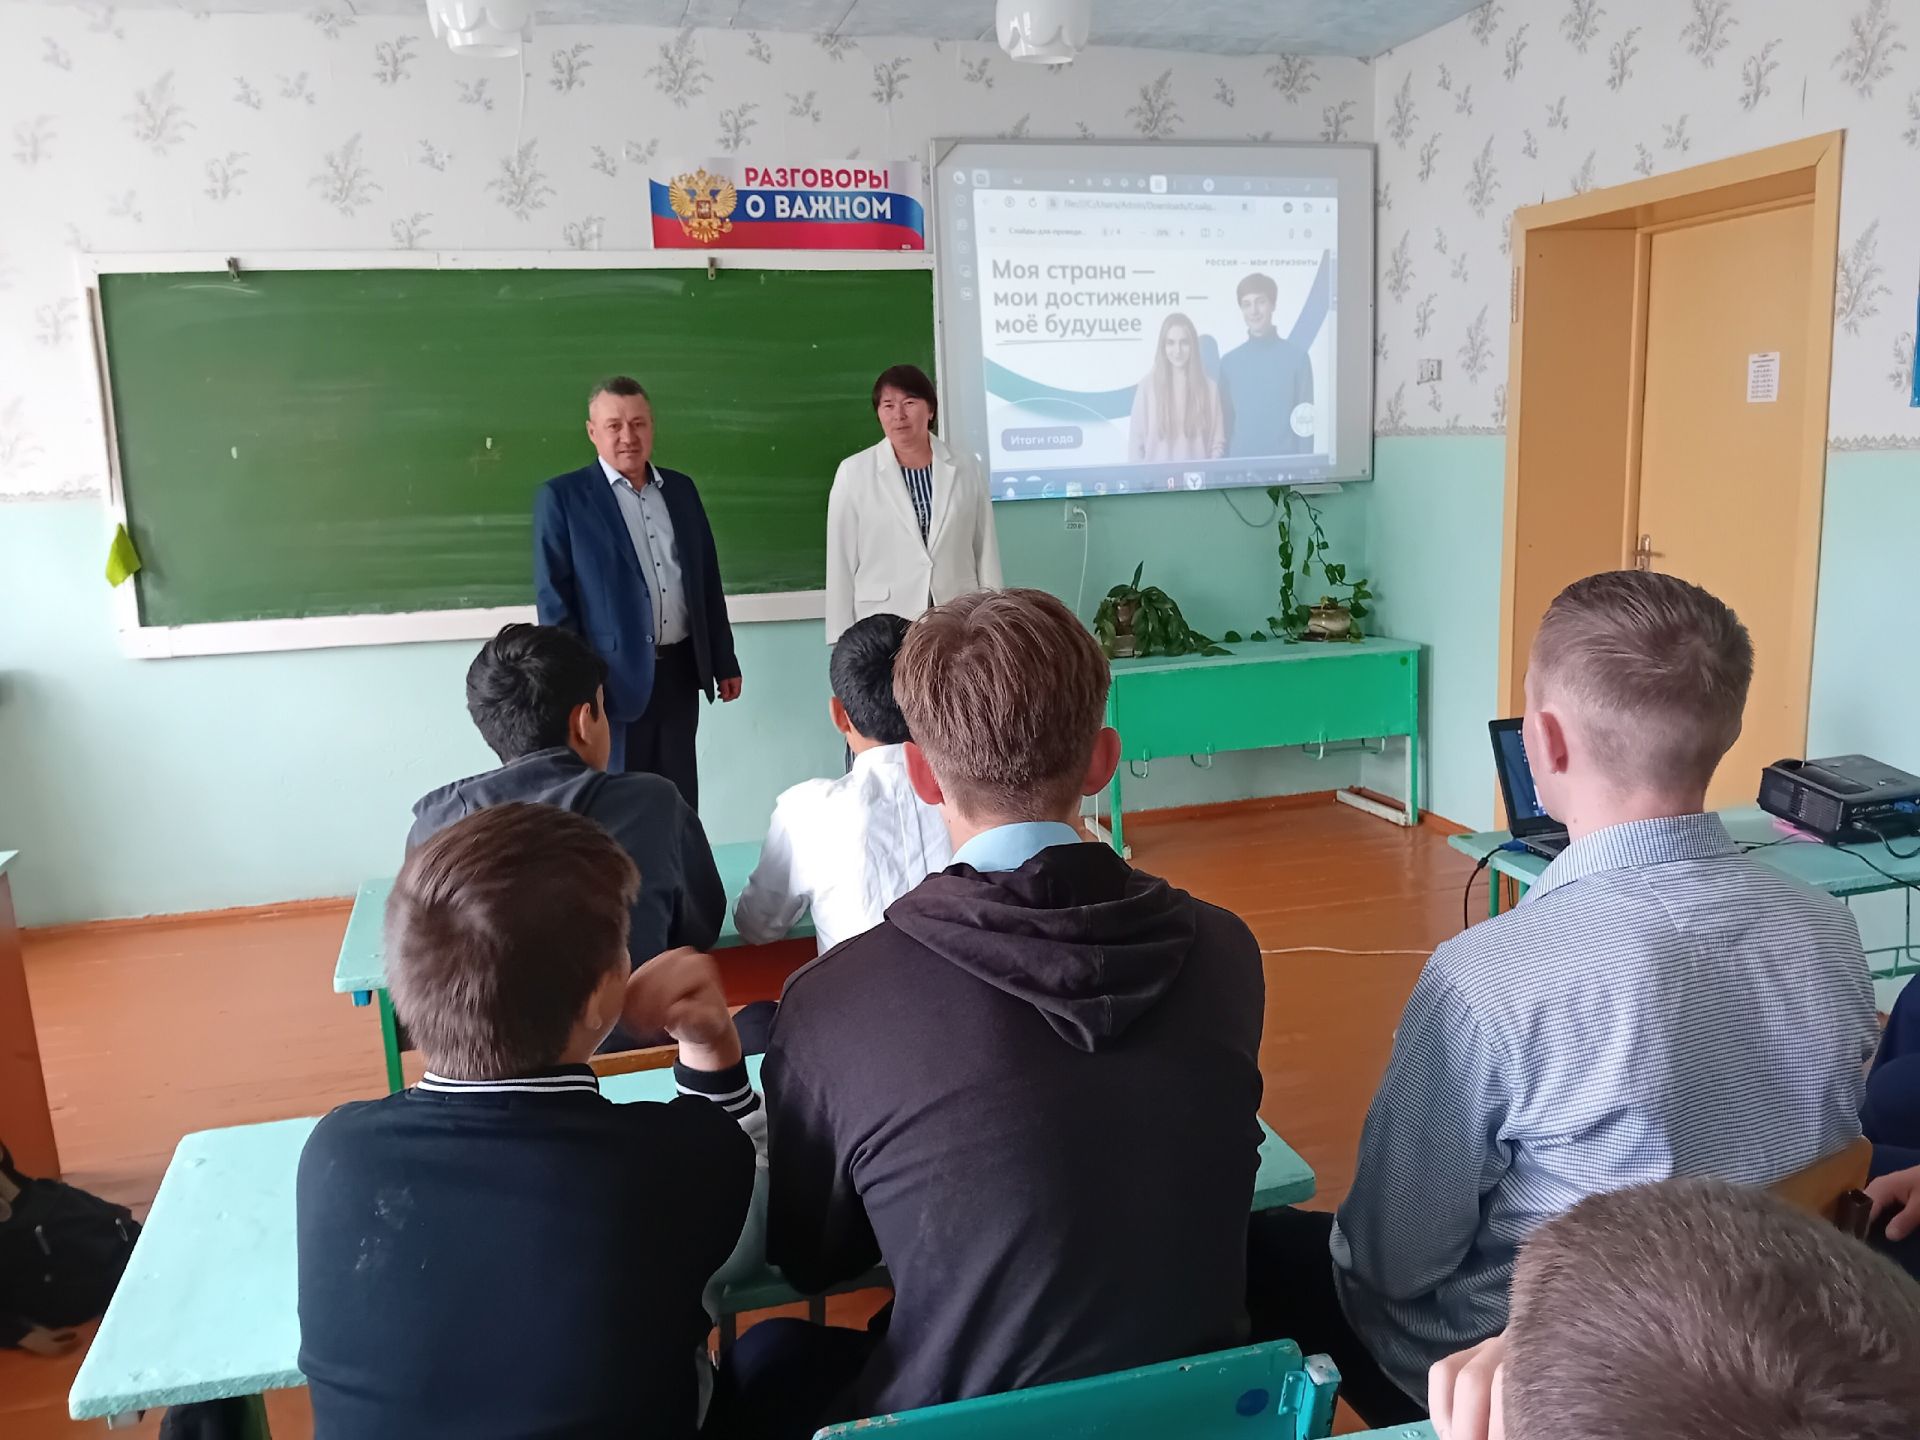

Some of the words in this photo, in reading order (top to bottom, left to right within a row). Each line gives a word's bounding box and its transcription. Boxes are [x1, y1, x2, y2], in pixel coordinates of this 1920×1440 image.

[744, 167, 889, 189] РАЗГОВОРЫ
[745, 194, 766, 219] О
[774, 195, 892, 220] ВАЖНОМ
[992, 259, 1039, 280] Моя
[1047, 264, 1126, 285] страна
[1205, 258, 1238, 266] РОССИЯ
[1270, 258, 1318, 267] ГОРИЗОНТЫ
[993, 291, 1038, 306] мои
[1045, 290, 1180, 309] достижения
[995, 314, 1038, 334] моё
[1045, 313, 1142, 338] будущее
[1010, 434, 1044, 446] Итоги
[1047, 434, 1074, 446] года
